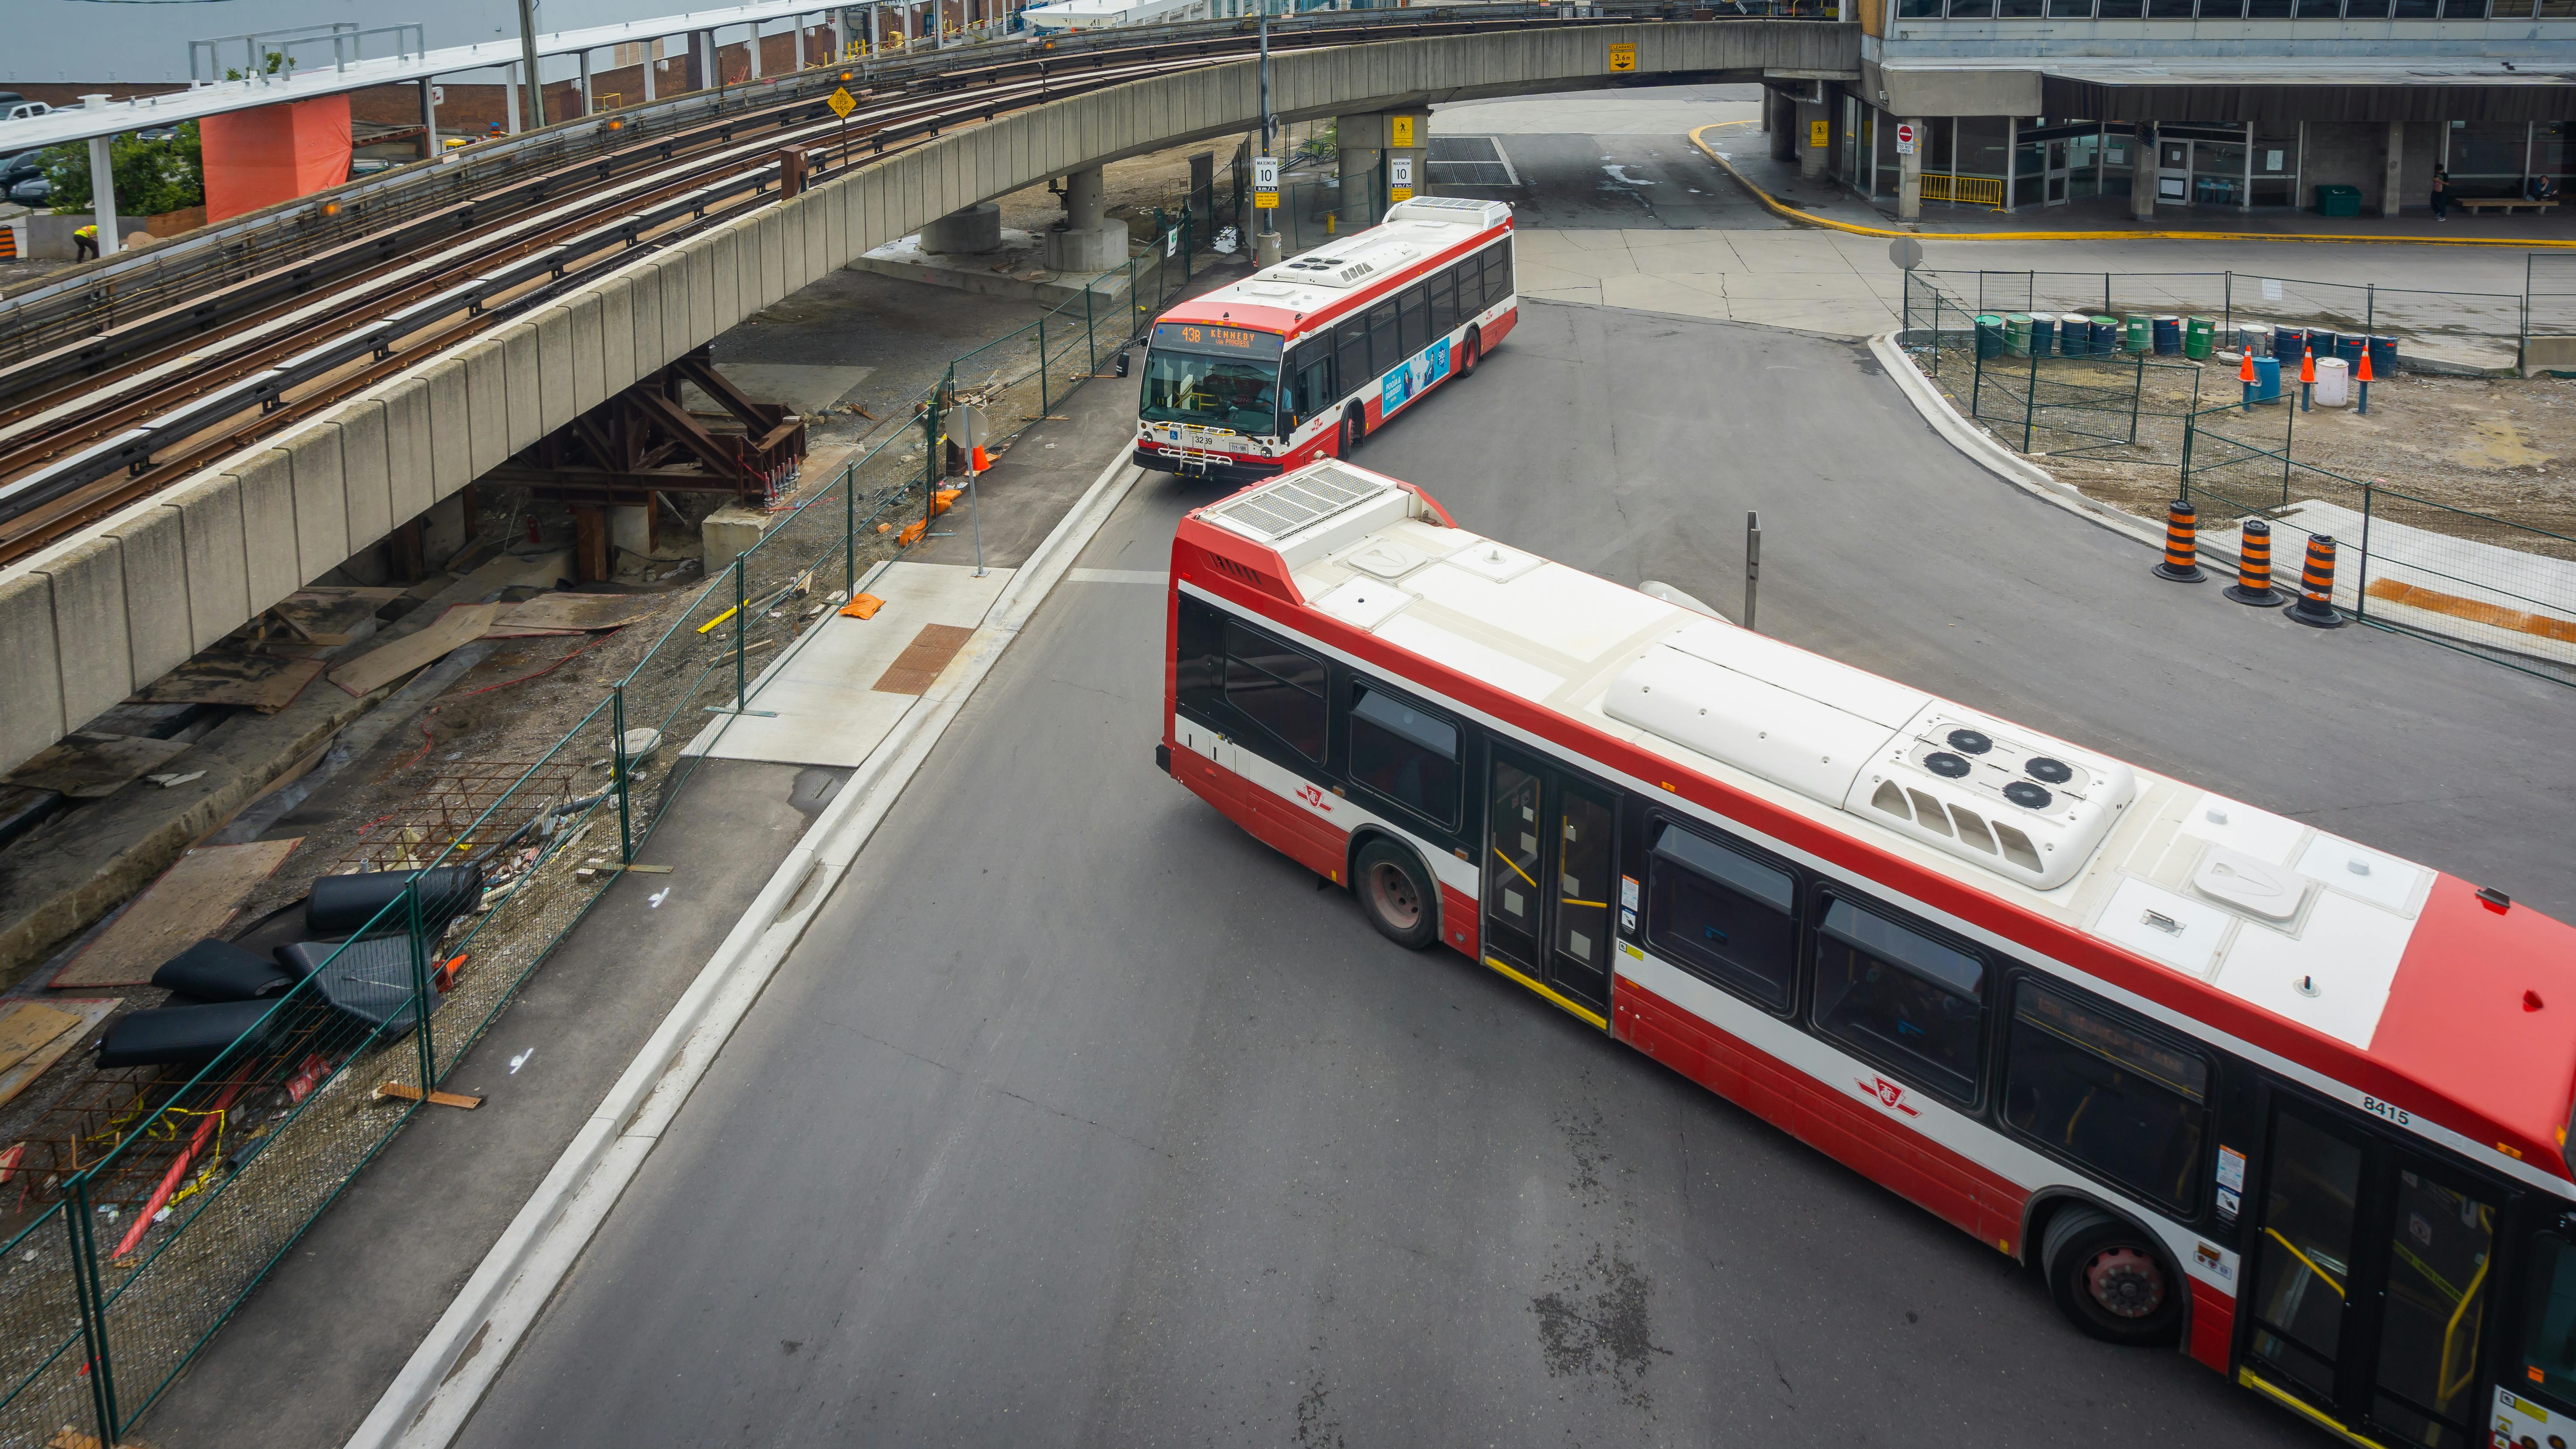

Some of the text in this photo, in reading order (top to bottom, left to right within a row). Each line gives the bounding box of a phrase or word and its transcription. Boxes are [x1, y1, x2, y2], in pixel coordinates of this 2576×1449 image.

[1261, 169, 1272, 182] 10
[1396, 169, 1407, 179] 10
[1182, 327, 1255, 343] 43B KENNEDY
[1225, 338, 1250, 348] PROGRESS
[1385, 384, 1402, 400] GURDEEP
[1386, 378, 1398, 392] POOJA
[2363, 1096, 2409, 1125] 8415
